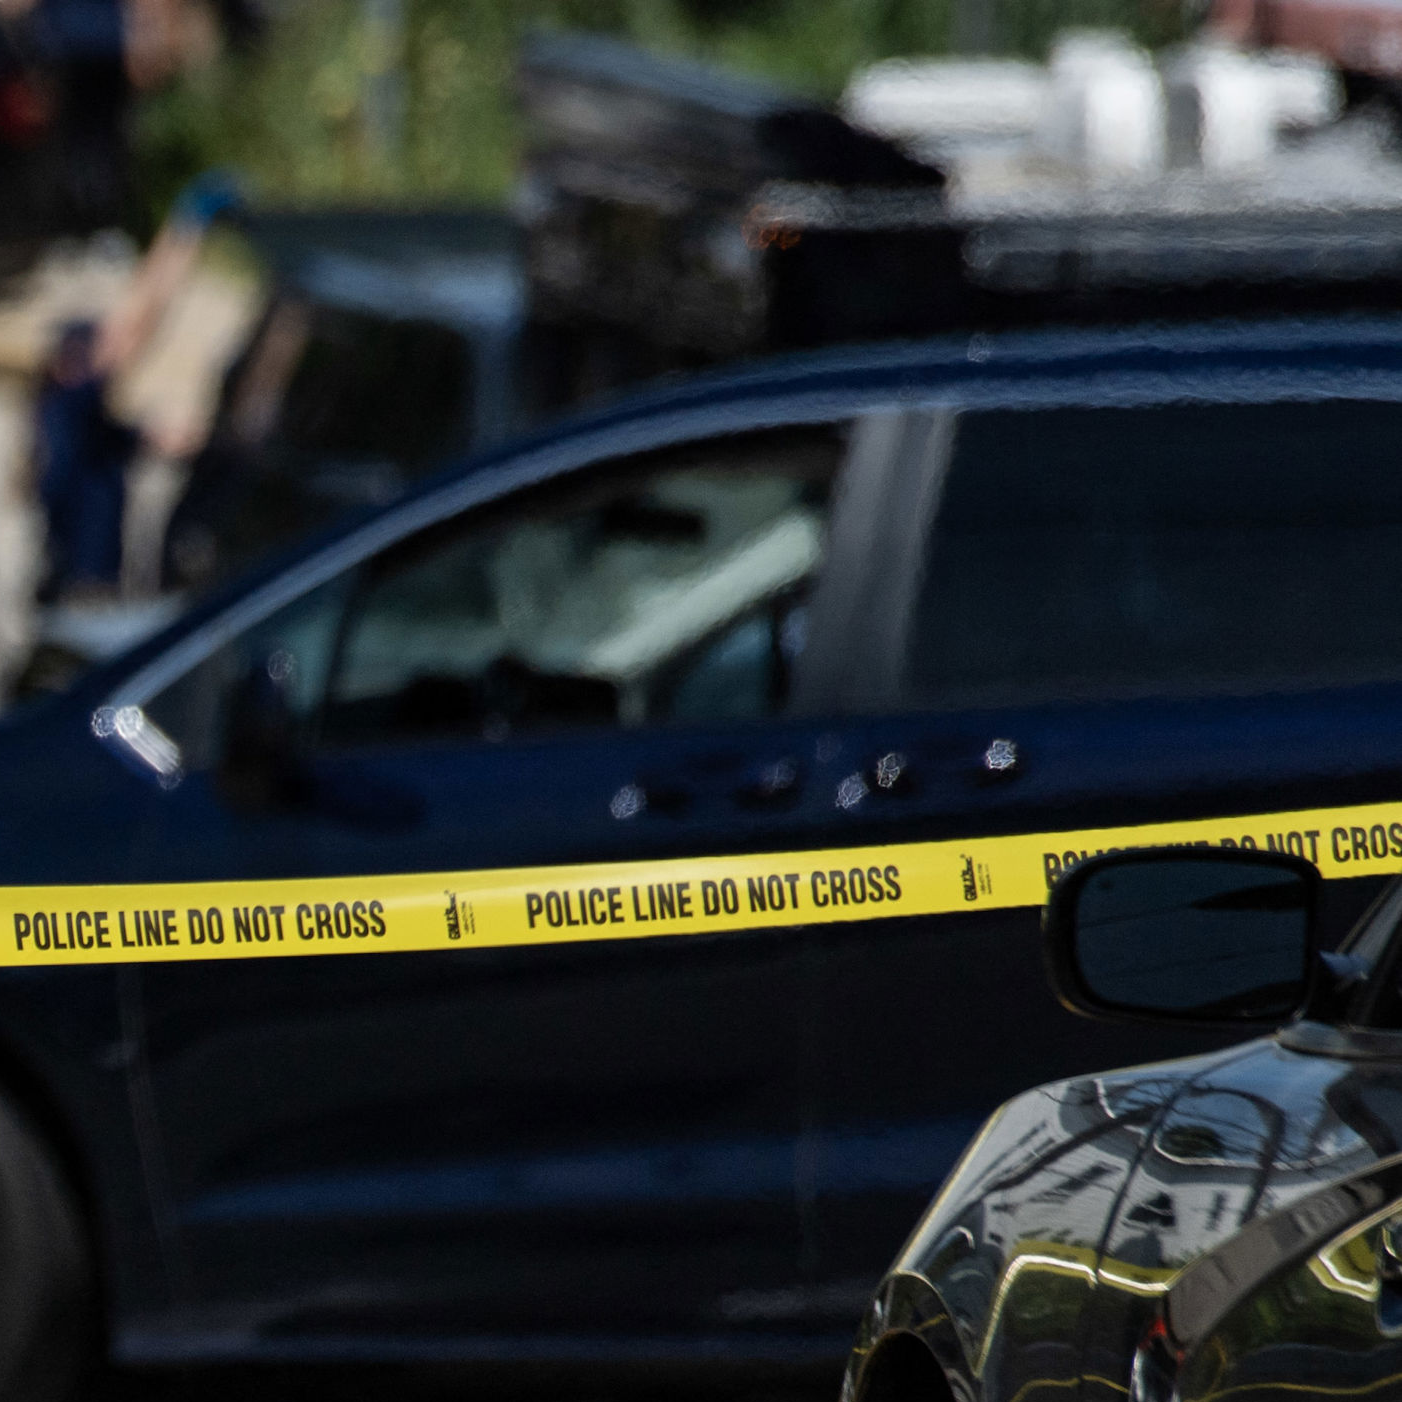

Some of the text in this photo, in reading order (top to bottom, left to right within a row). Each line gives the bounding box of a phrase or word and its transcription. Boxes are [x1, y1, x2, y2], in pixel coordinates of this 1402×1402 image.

[1330, 822, 1402, 864] CROS
[525, 864, 902, 929] POLICE LINE DO NOT CROSS
[13, 899, 387, 951] POLICE LINE DO NOT CROSS
